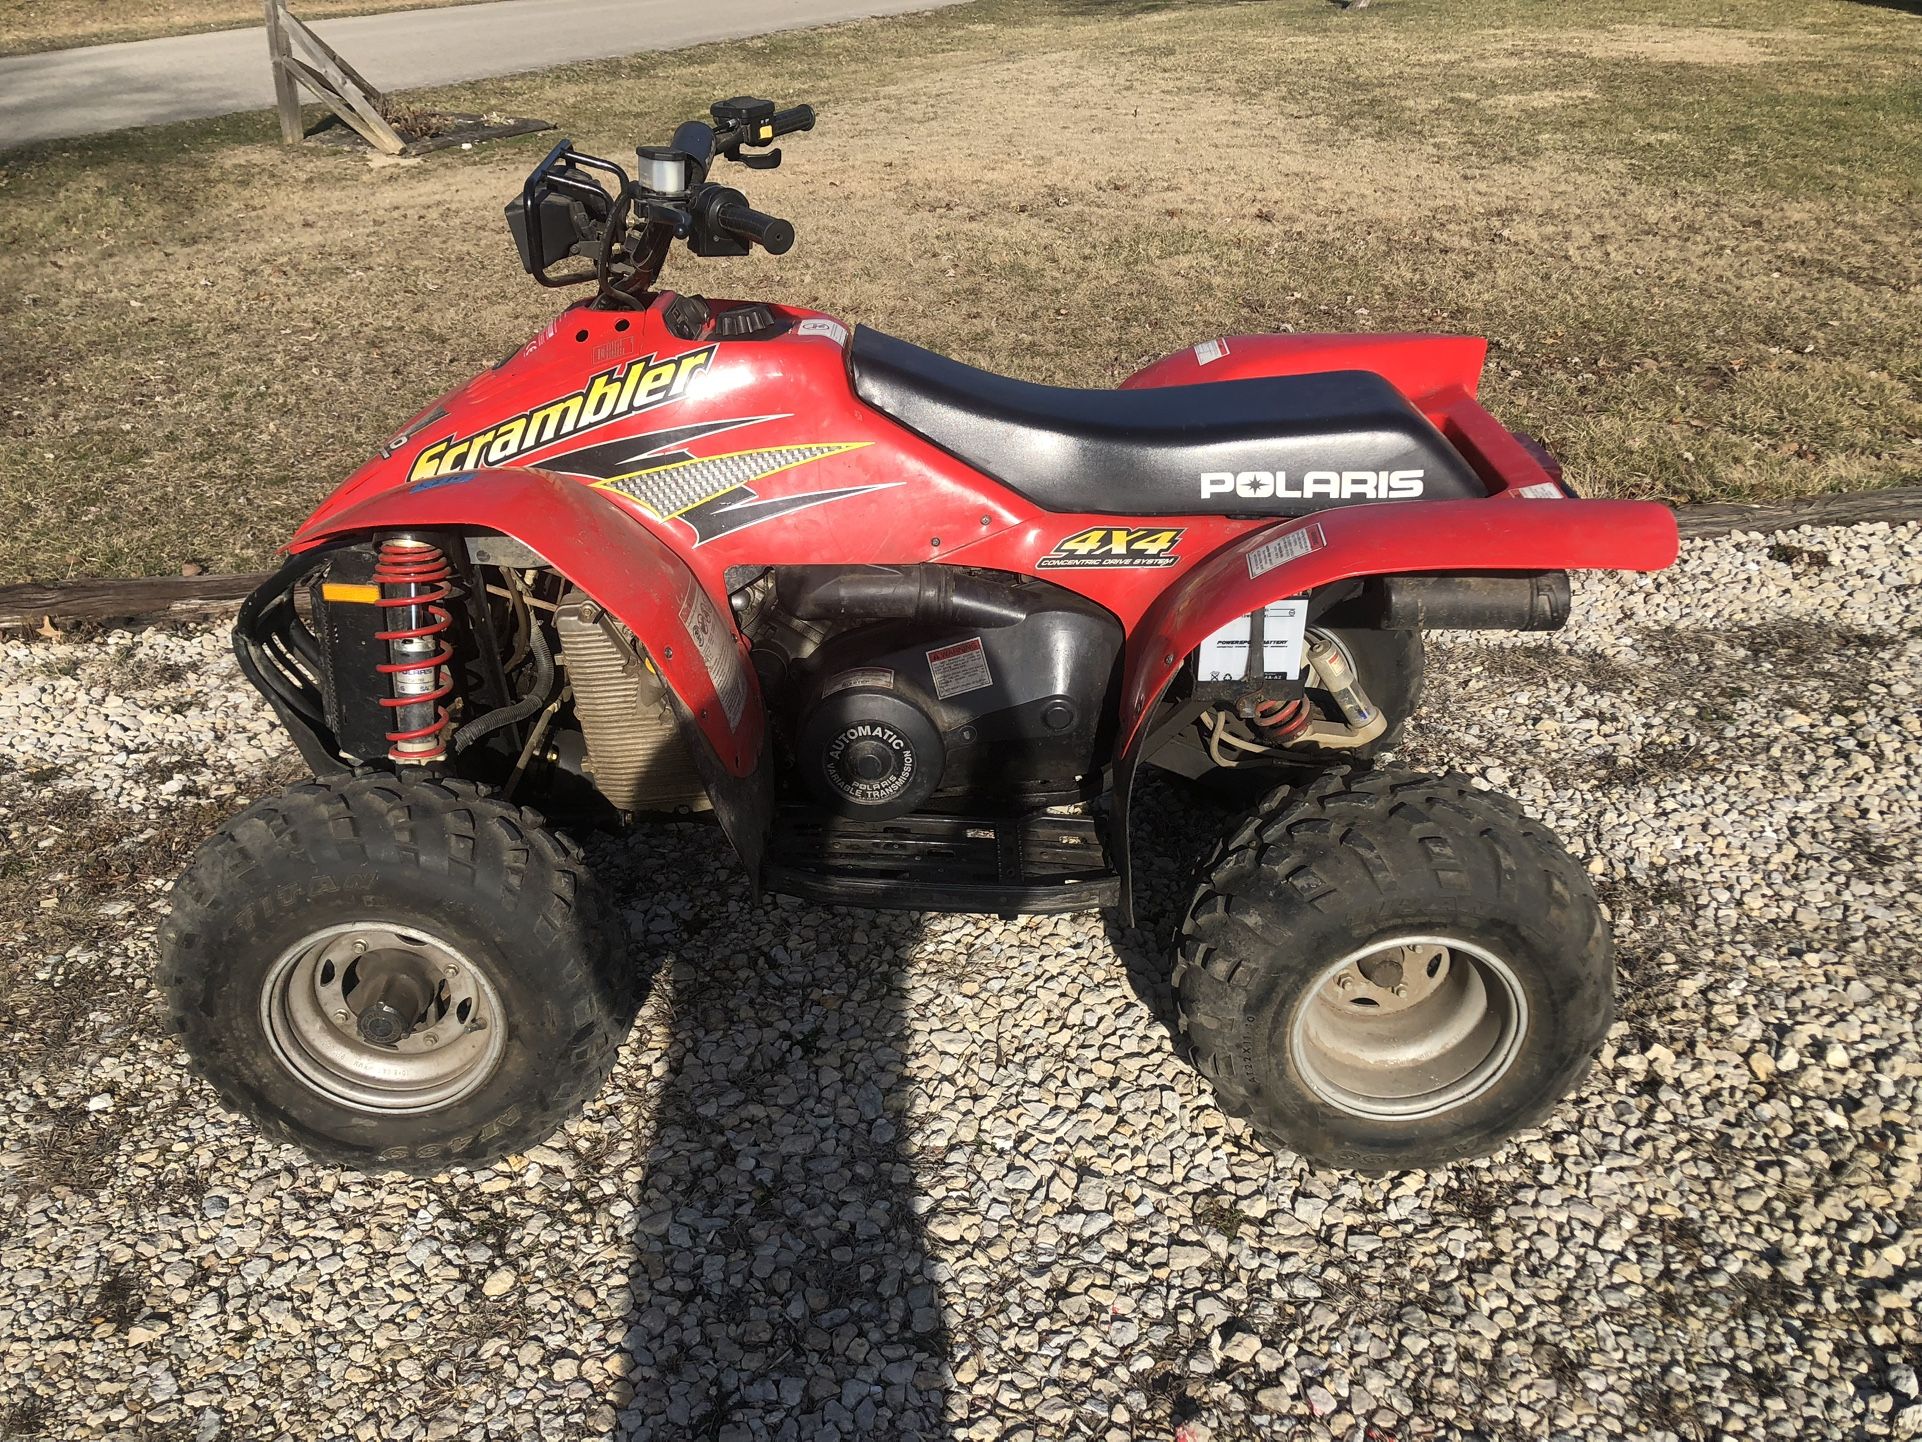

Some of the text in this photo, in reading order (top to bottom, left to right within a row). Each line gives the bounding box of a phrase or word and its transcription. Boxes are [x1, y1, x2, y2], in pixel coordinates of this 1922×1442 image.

[408, 348, 698, 482] Scrambler
[1200, 469, 1425, 499] POLARIS
[1060, 530, 1178, 555] 4X4
[1040, 557, 1174, 567] CONCENTRIC DRIVE SYSTEM
[829, 725, 904, 760] AUTOMATIC
[827, 750, 913, 799] VARIABLE TRANSMISSION
[851, 774, 897, 792] POLARIS
[232, 872, 377, 931] TITAN
